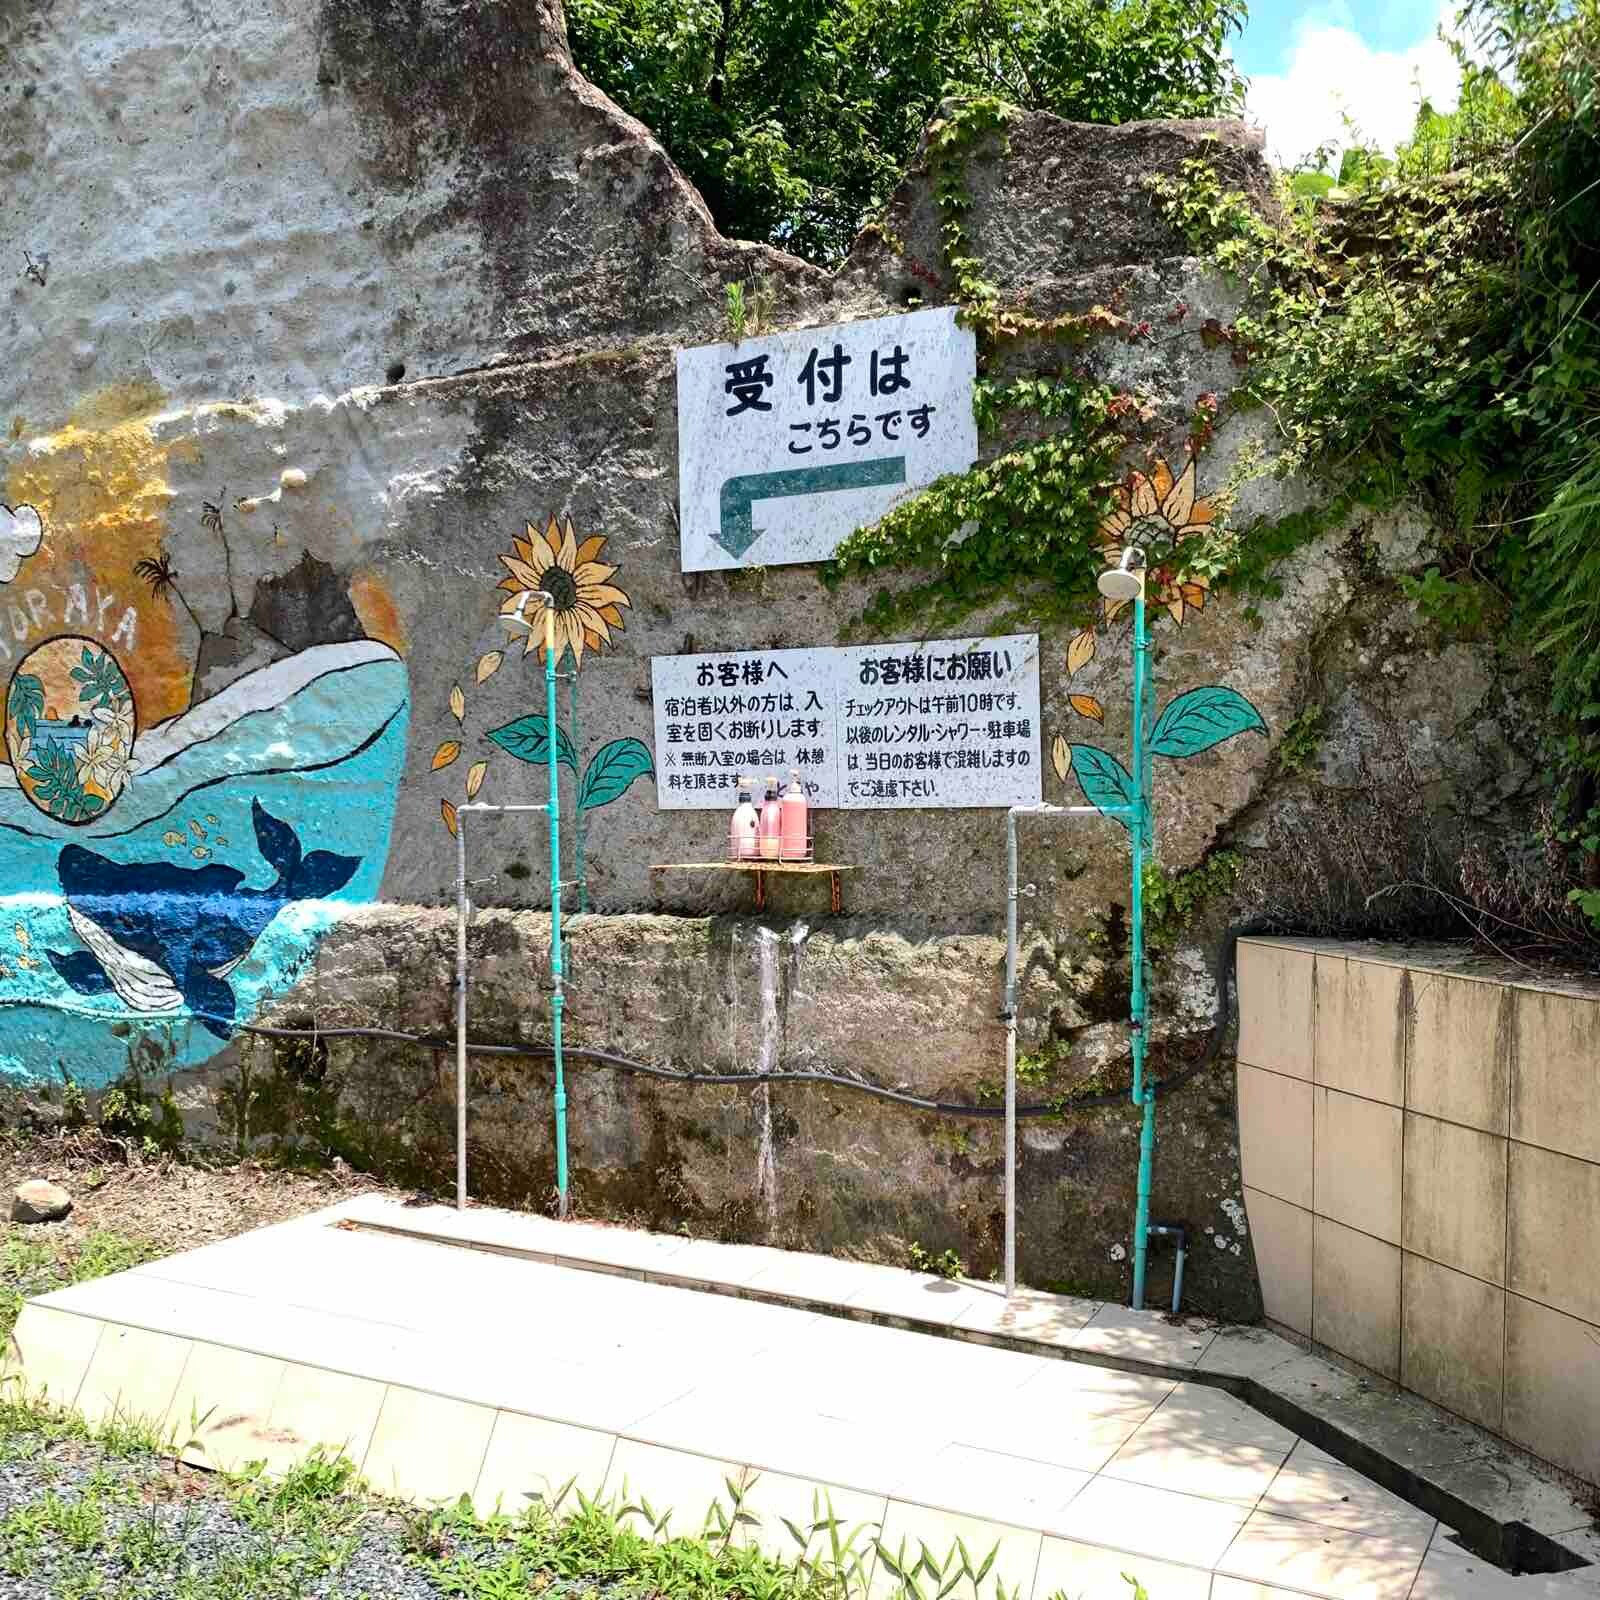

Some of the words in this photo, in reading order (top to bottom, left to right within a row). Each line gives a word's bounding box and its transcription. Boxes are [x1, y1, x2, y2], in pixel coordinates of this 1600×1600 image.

[725, 344, 911, 417] 受付は
[788, 403, 936, 454] こちらです
[696, 659, 788, 687] お客様へ
[859, 650, 1012, 685] お客様にお願い
